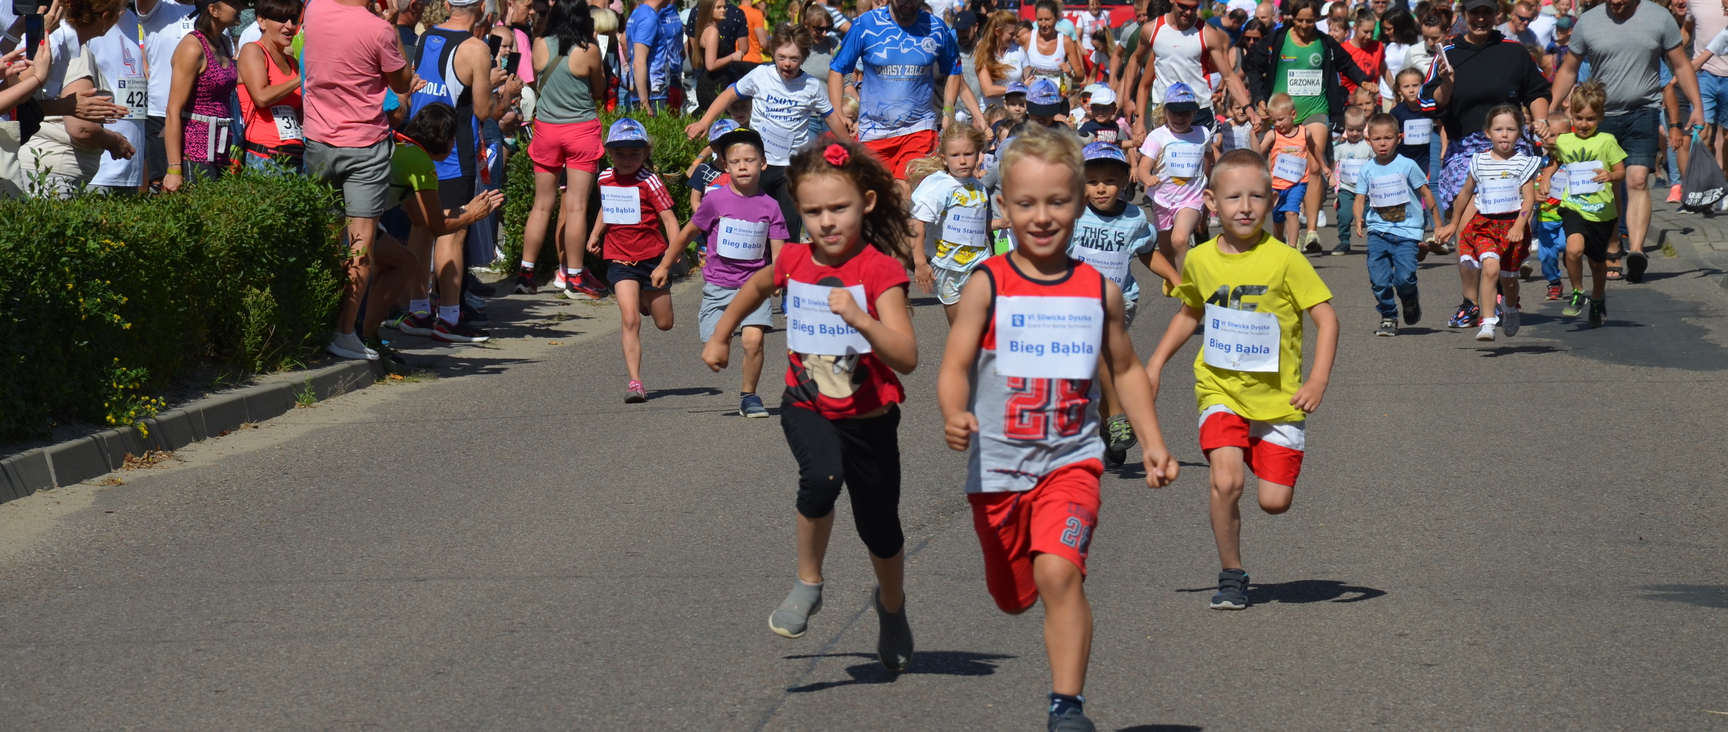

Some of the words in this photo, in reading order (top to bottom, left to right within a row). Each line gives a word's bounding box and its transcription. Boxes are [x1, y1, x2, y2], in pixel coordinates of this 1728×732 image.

[875, 64, 903, 76] MORSY
[1289, 79, 1321, 87] GRZONKA
[615, 206, 635, 215] Bąbla
[1082, 225, 1109, 240] THIS
[1113, 230, 1125, 243] IS
[722, 238, 740, 249] Bieg
[742, 241, 762, 251] Bąbla
[1080, 236, 1125, 252] WHAT
[1068, 314, 1092, 323] Dyszka
[792, 318, 815, 336] Bieg
[819, 323, 858, 338] Bąbla
[1009, 340, 1045, 357] Bieg
[1051, 341, 1094, 357] Bąbla
[1209, 337, 1231, 353] Bieg
[1235, 343, 1270, 356] Bąbla
